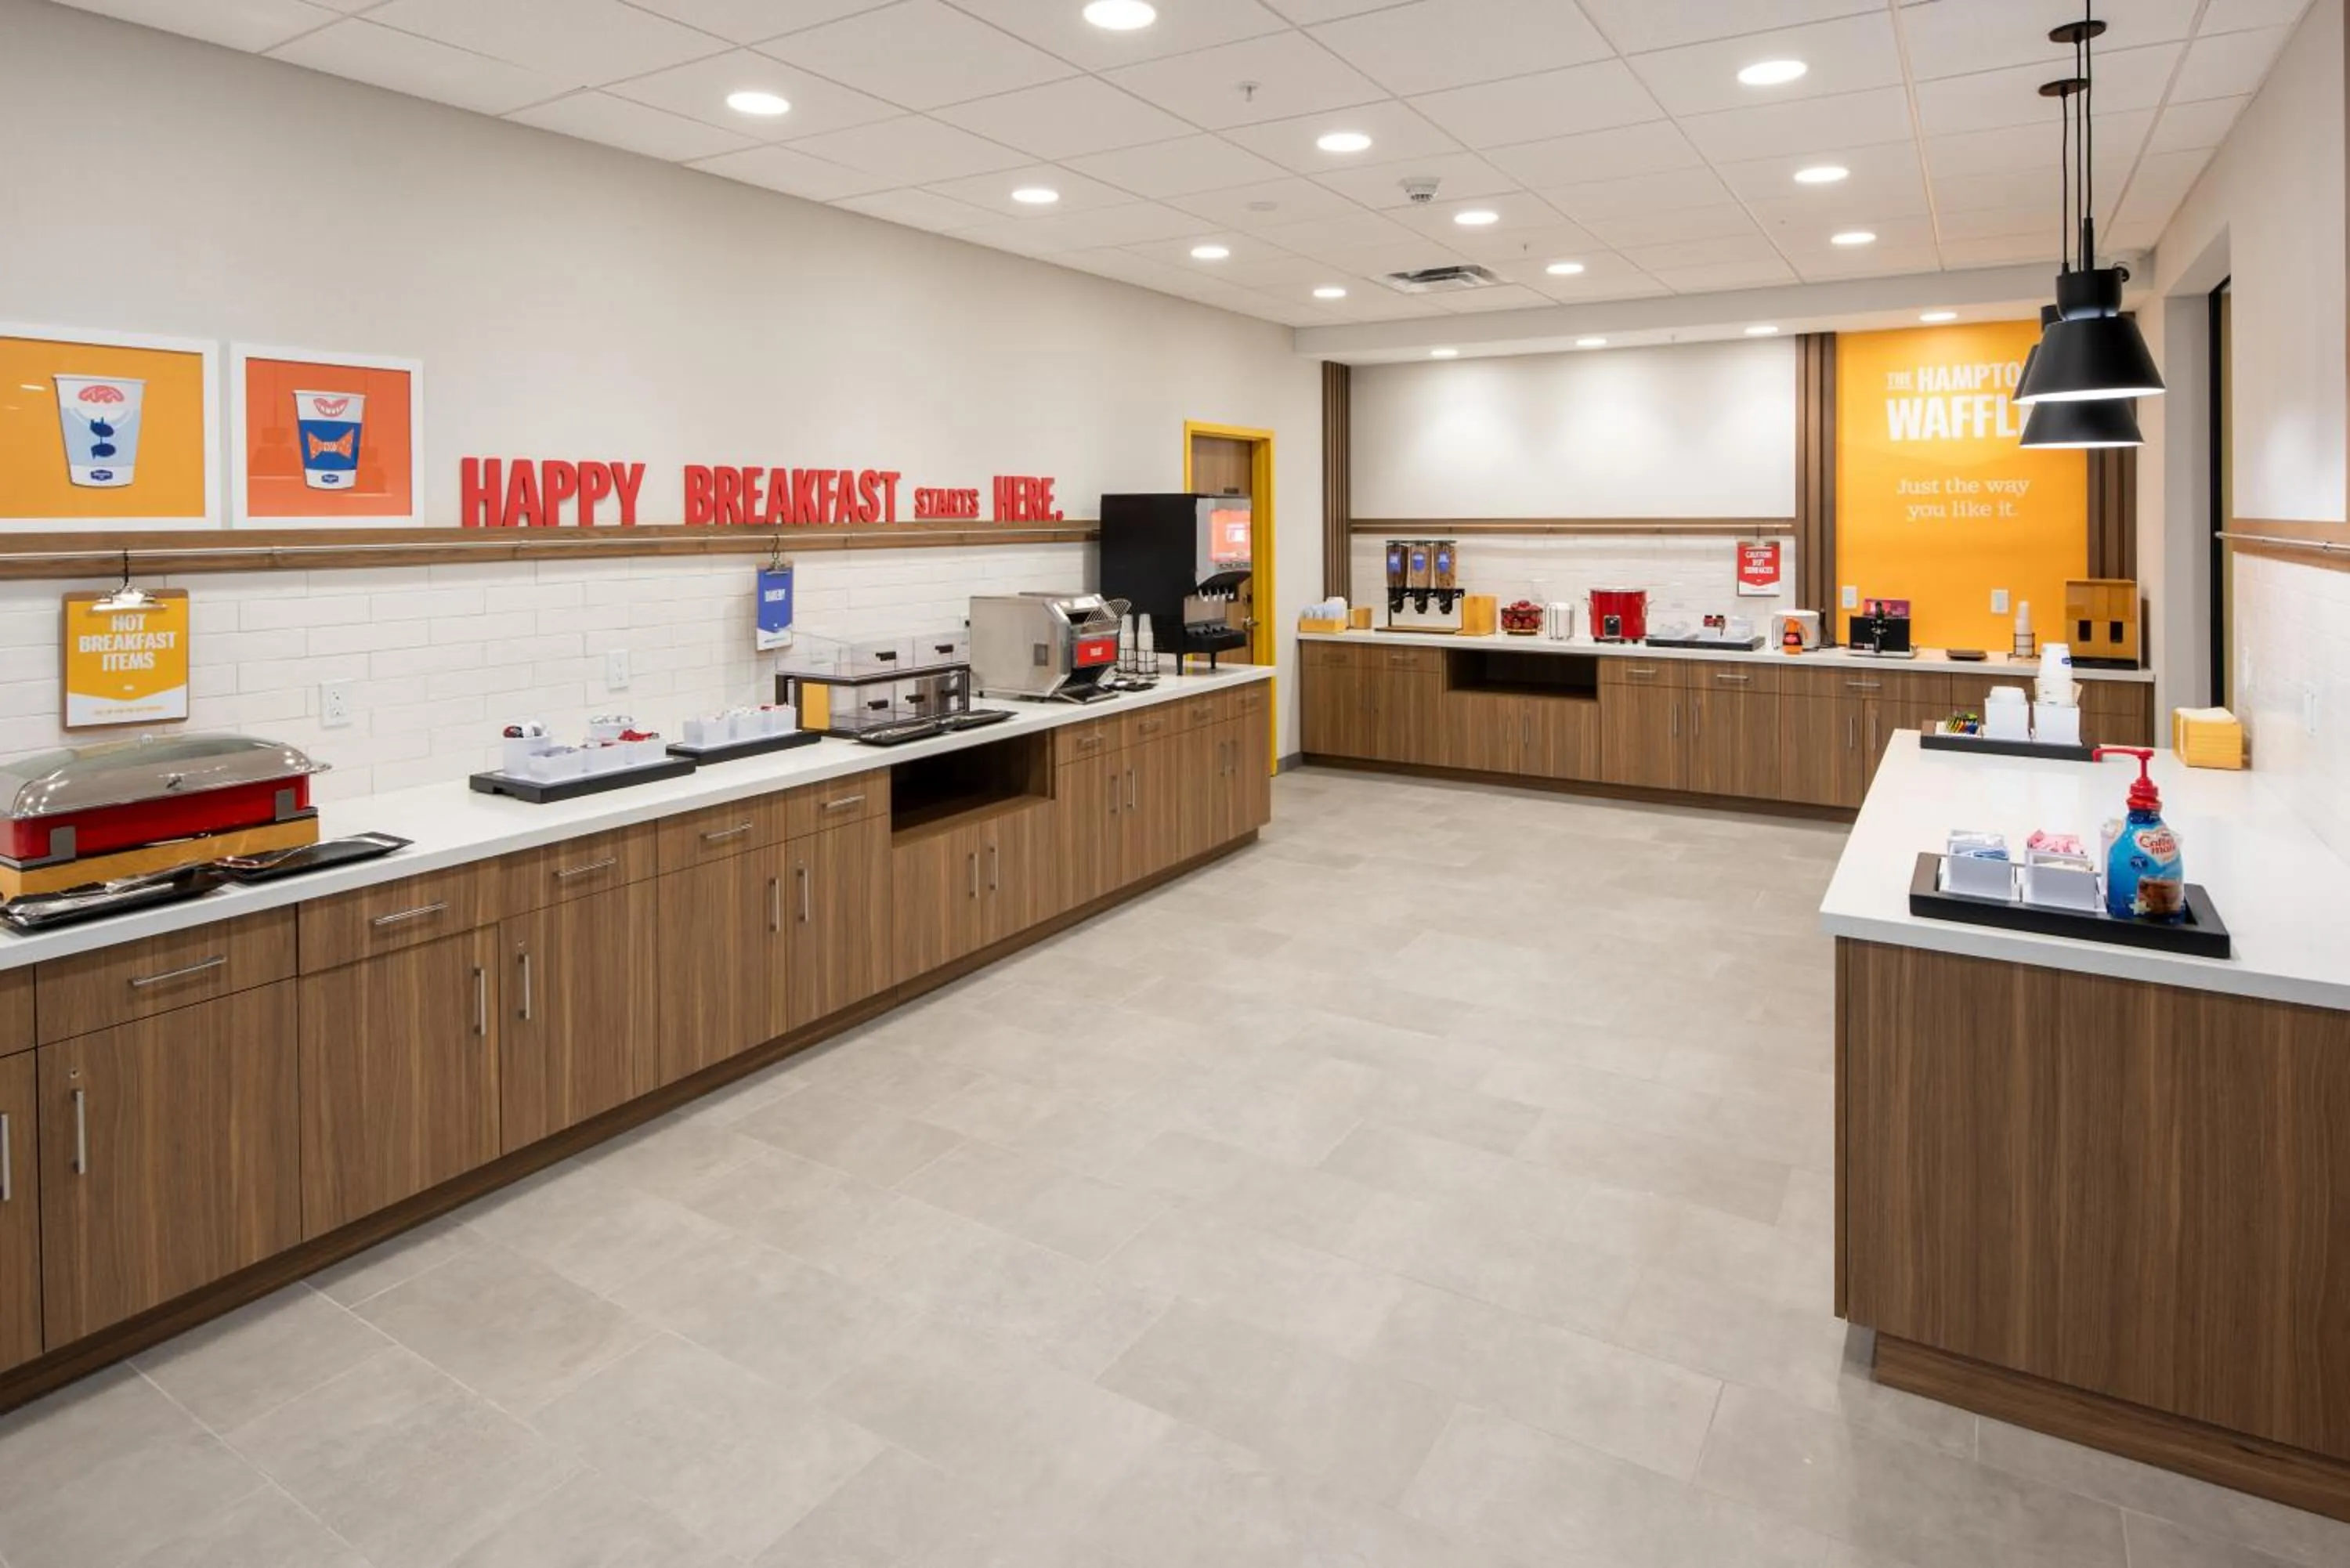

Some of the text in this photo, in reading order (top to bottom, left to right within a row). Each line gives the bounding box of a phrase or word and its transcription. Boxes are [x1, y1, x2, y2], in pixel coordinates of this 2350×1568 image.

[1887, 362, 2023, 392] THE HAMPTO
[1886, 395, 2035, 441] WAFFL
[461, 457, 1065, 528] HAPPY BREAKFAST STARTS HERE.
[1897, 479, 2031, 497] Just the way
[1907, 499, 2019, 522] you like it.
[111, 613, 146, 632] HOT
[79, 631, 175, 652] BREAKFAST
[103, 652, 155, 671] ITEMS
